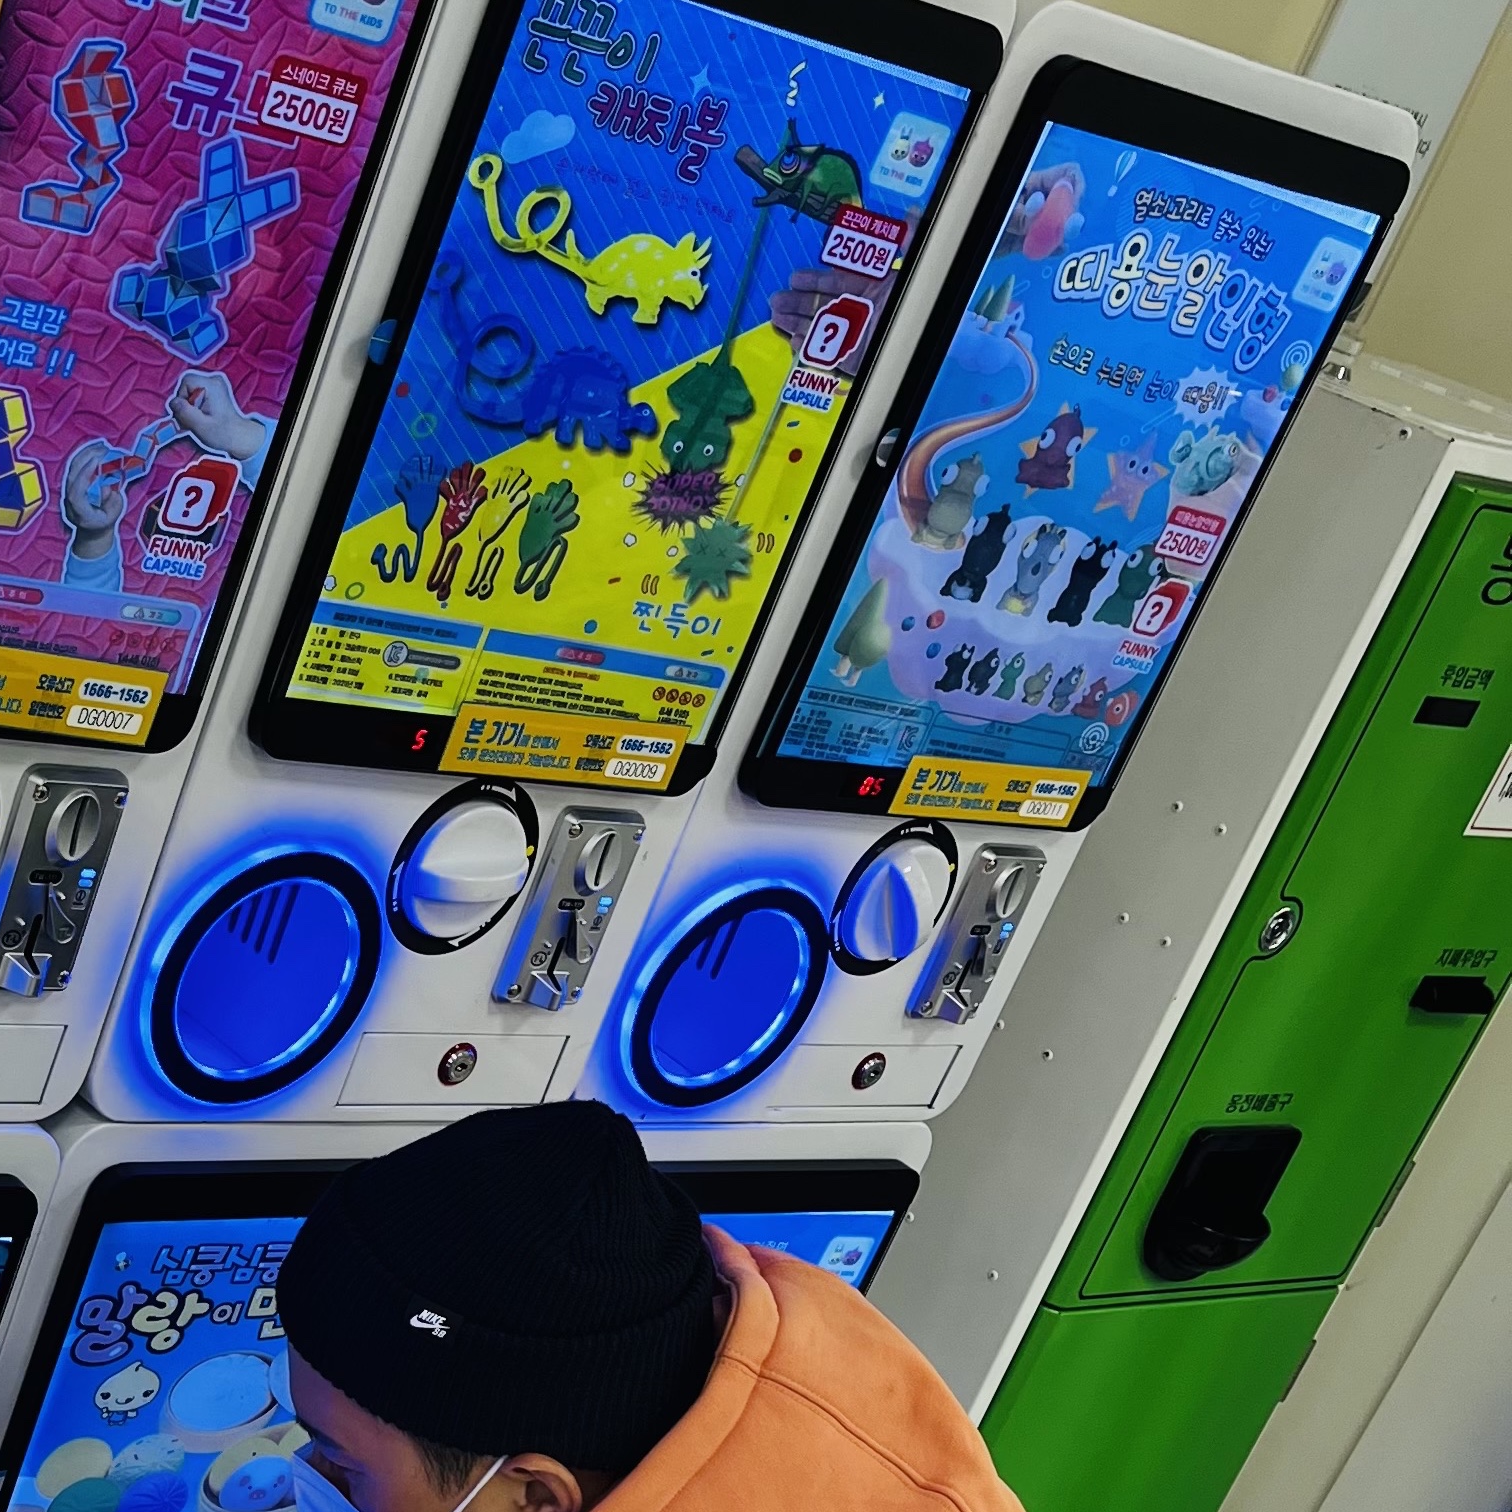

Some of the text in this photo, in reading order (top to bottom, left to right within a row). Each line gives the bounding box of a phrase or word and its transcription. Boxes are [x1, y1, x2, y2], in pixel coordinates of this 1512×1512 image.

[323, 2, 383, 30] TO THE KIDS
[280, 62, 331, 88] 스네이크
[267, 90, 352, 137] 2500원
[587, 81, 729, 184] 캐치볼
[1133, 188, 1214, 229] 열쇠고리로
[826, 233, 892, 272] 2500원
[1056, 231, 1290, 370] 띠용눈알인형
[788, 369, 840, 395] FUNNY
[1048, 336, 1095, 376] 손으로
[1144, 371, 1180, 403] 눈이
[782, 387, 833, 411] CAPSULE
[653, 470, 717, 493] SUPER
[149, 537, 211, 560] FUNNY
[1159, 530, 1212, 560] 2500원
[143, 556, 205, 578] CAPSULE
[632, 601, 722, 639] 찐득이
[1118, 639, 1160, 660] FUNNY
[1112, 655, 1153, 671] CAPSULE
[83, 682, 149, 704] 1666-1562
[77, 707, 135, 730] DG0007
[464, 718, 487, 744] 본
[620, 738, 673, 755] 1666-1562
[418, 1309, 447, 1326] NIKE
